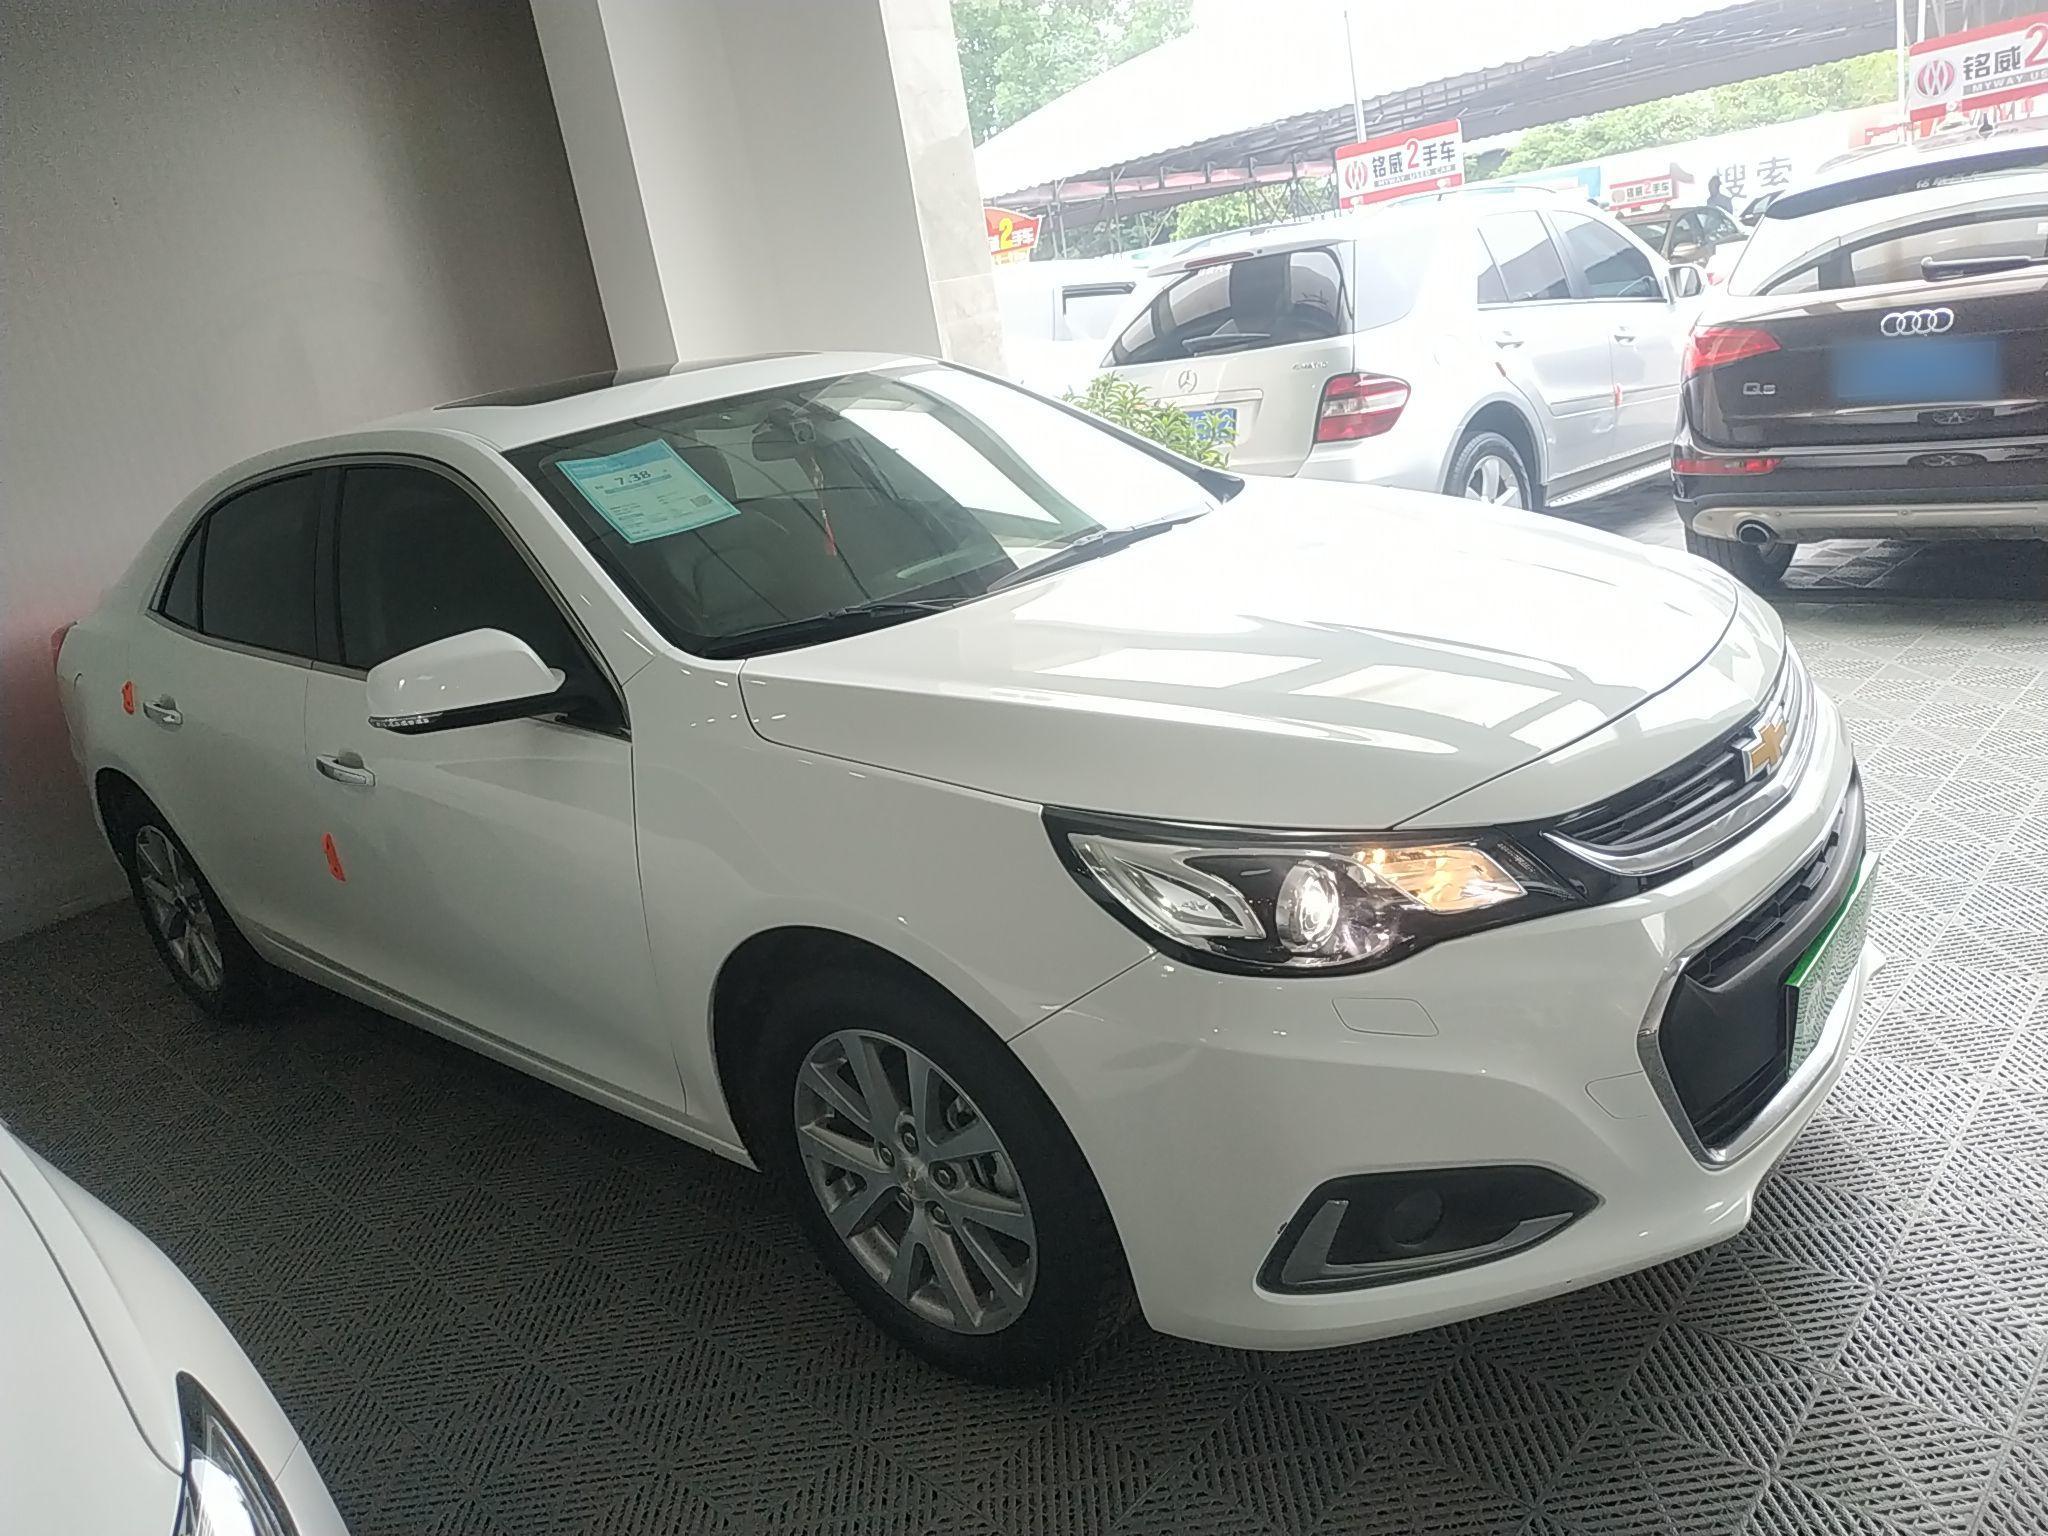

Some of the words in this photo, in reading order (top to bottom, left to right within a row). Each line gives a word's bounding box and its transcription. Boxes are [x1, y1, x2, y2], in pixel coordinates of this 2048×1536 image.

[1971, 75, 2024, 93] MYWAY
[1372, 140, 1456, 179] 铭威2手车
[614, 470, 652, 487] 7.38
